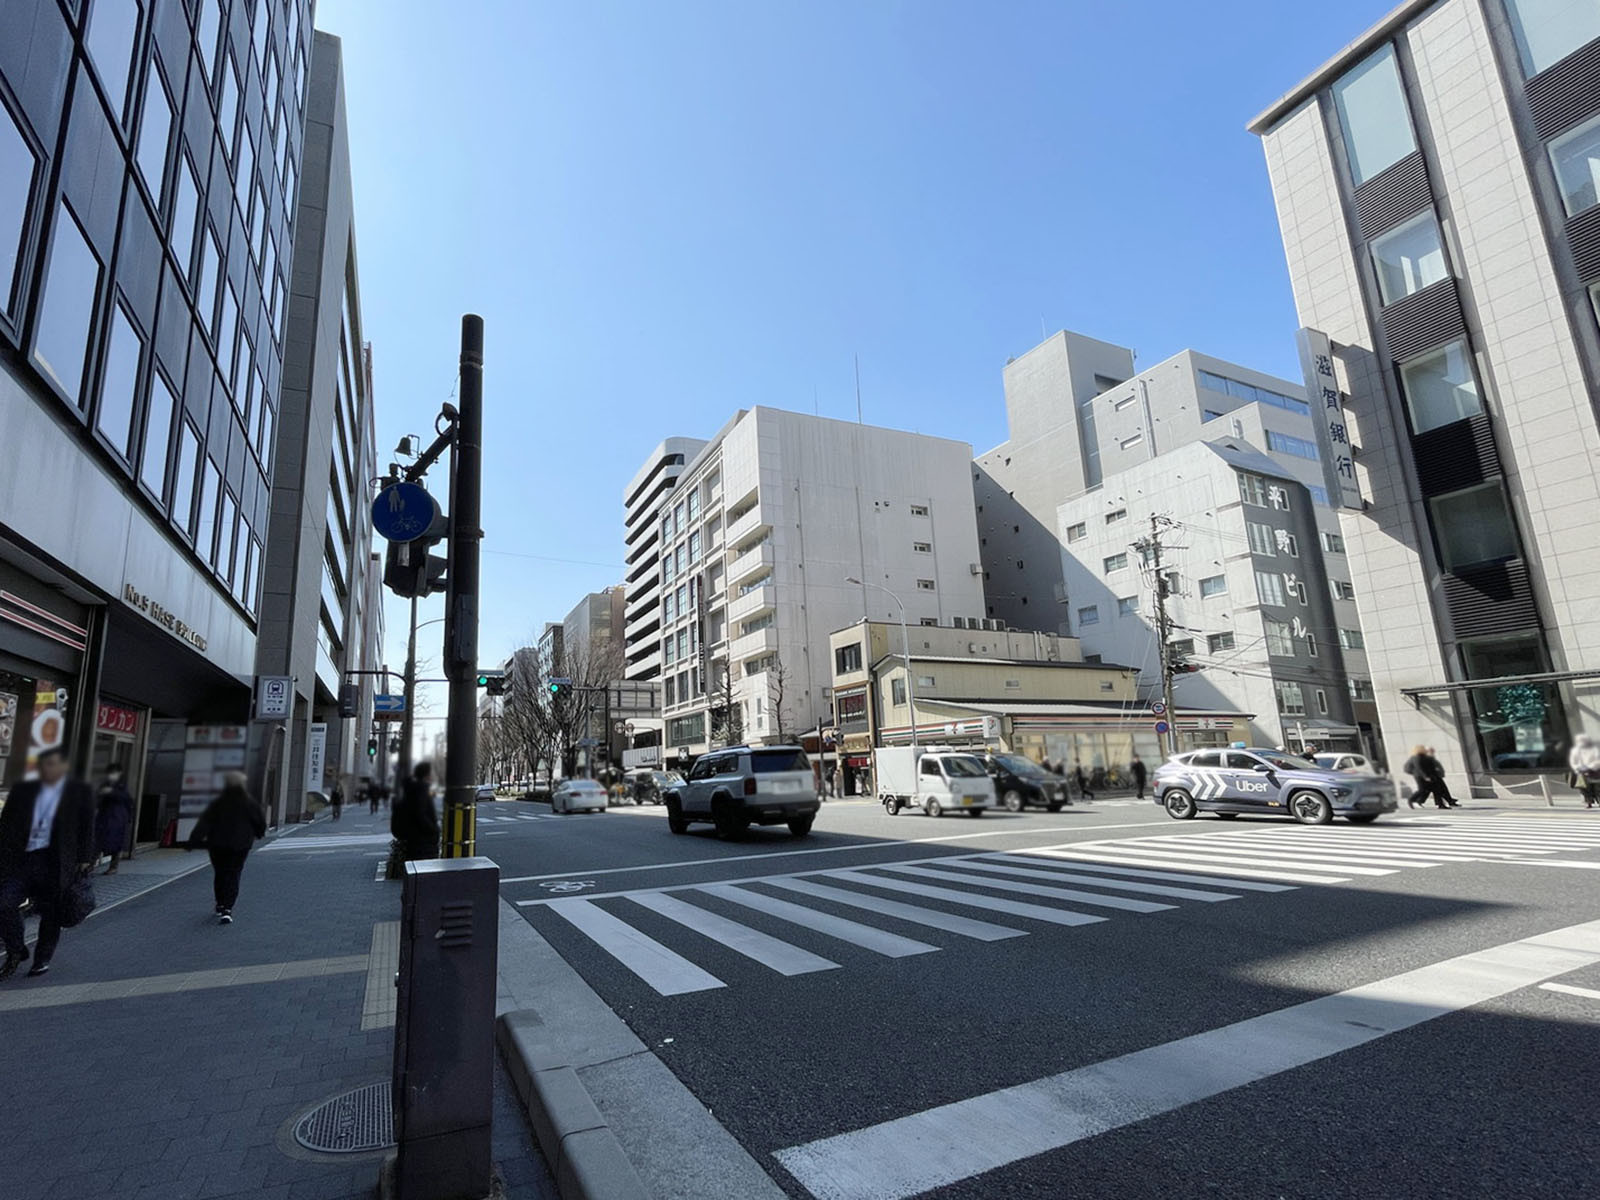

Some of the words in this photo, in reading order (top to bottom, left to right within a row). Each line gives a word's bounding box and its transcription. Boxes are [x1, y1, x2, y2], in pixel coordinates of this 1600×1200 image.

[1316, 355, 1352, 479] 滋賀銀行
[1268, 485, 1307, 639] 平野ビル
[150, 601, 175, 630] HASE
[1235, 780, 1269, 793] Uber
